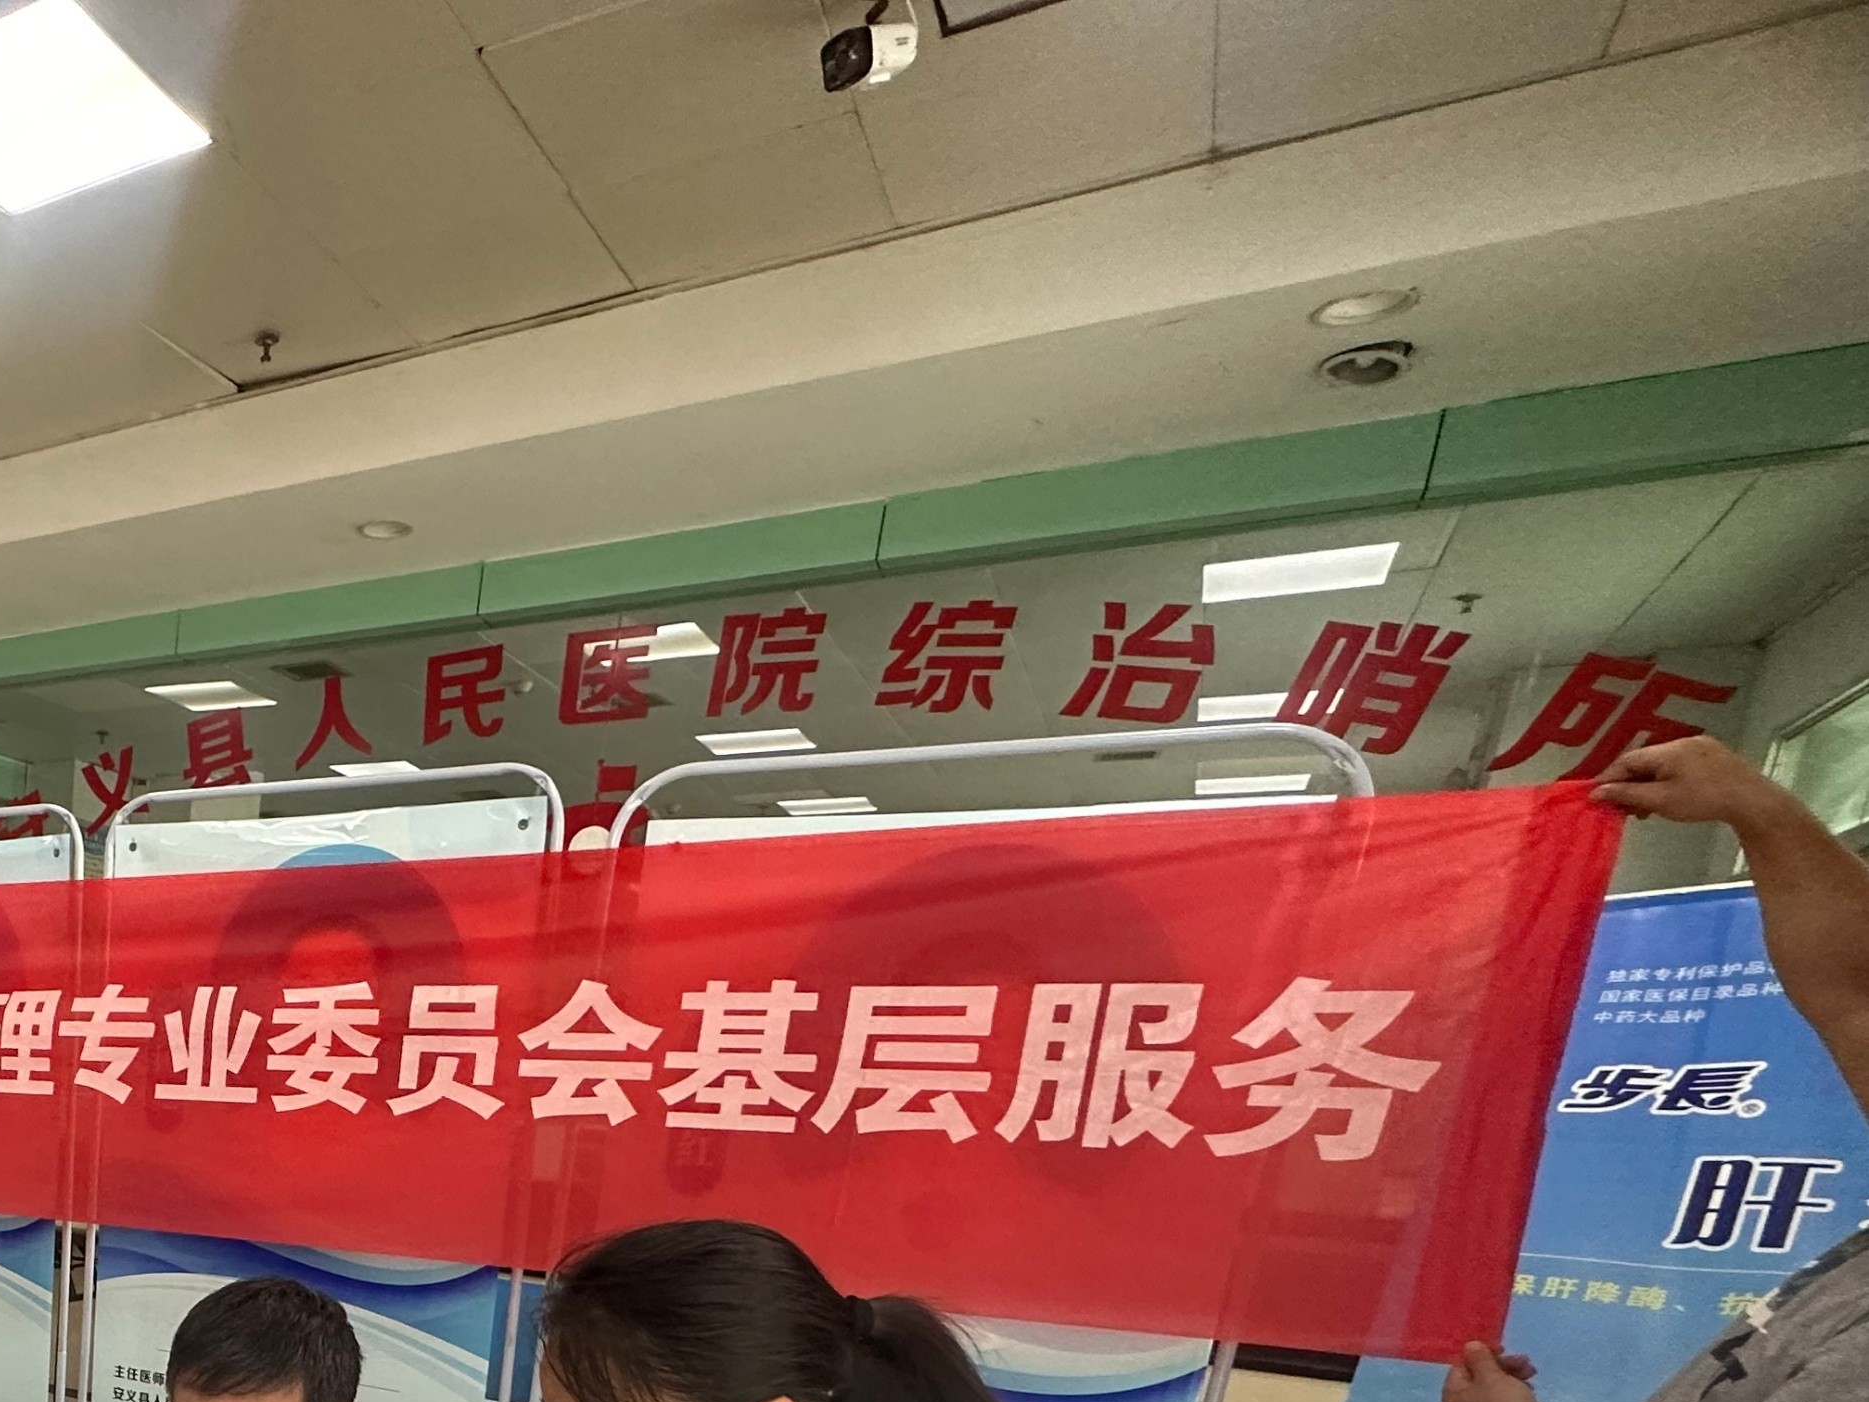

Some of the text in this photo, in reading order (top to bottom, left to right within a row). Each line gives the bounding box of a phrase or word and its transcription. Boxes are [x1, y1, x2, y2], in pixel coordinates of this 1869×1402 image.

[1593, 1009, 1706, 1025] 中药大品种
[113, 1365, 165, 1386] 主任医师
